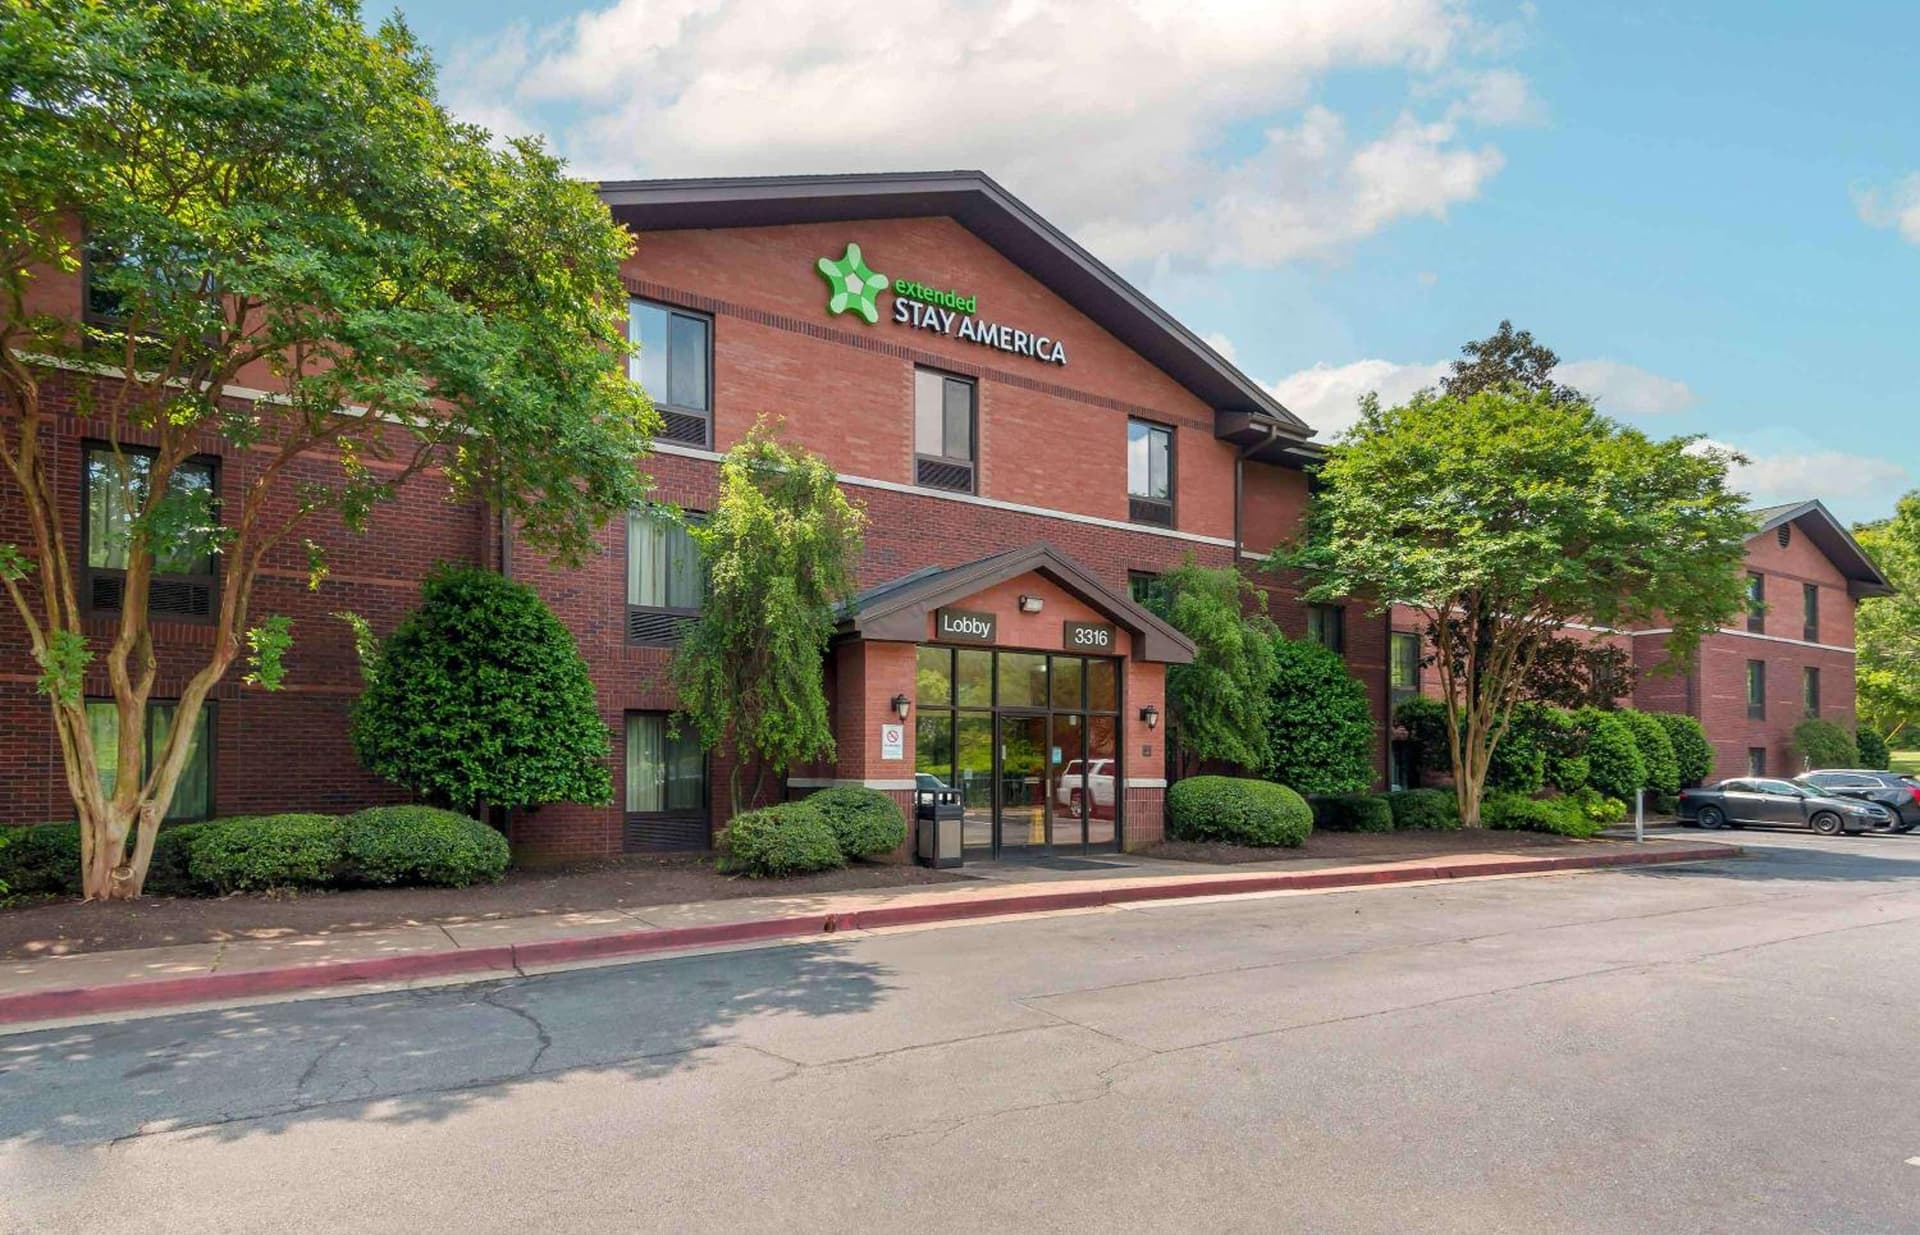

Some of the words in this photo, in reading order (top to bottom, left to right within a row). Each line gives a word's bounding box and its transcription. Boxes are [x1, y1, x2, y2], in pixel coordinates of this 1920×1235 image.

[895, 279, 976, 314] extended
[895, 296, 956, 334] STAY
[958, 315, 1067, 365] AMERICA
[943, 614, 991, 639] Lobby
[1074, 627, 1108, 646] 3316
